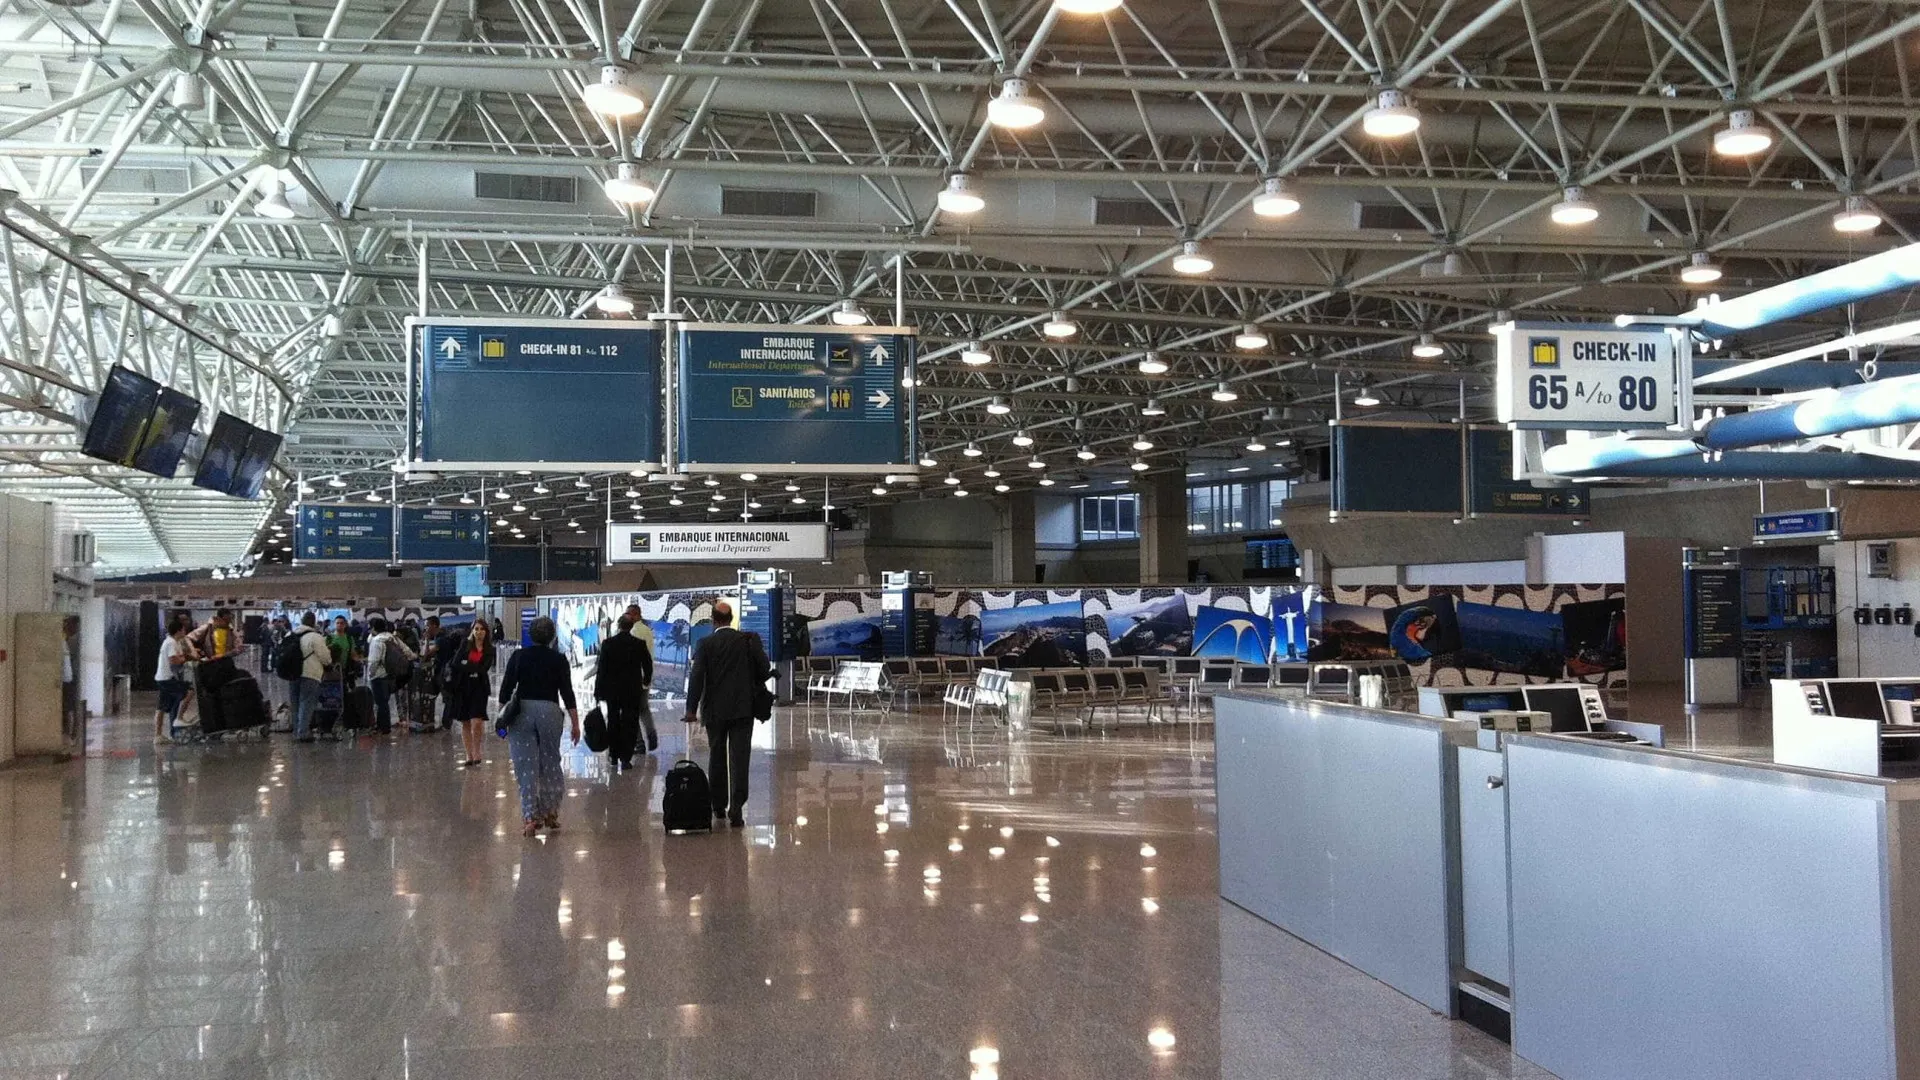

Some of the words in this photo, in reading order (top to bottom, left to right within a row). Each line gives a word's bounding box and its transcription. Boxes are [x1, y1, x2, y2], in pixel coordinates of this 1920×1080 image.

[763, 337, 815, 349] EMBARQUE
[520, 343, 568, 355] CHECK-IN
[570, 344, 581, 355] 81
[599, 345, 618, 356] 112
[740, 348, 815, 360] INTERNACIONAL
[1573, 341, 1656, 362] CHECK-IN
[759, 385, 815, 399] SANITÁRIOS
[1529, 374, 1568, 410] 65
[1619, 375, 1657, 411] 80
[659, 532, 712, 543] EMBARQUE
[714, 531, 790, 542] INTERNACIONAL
[660, 544, 720, 553] International
[722, 544, 771, 554] Departures
